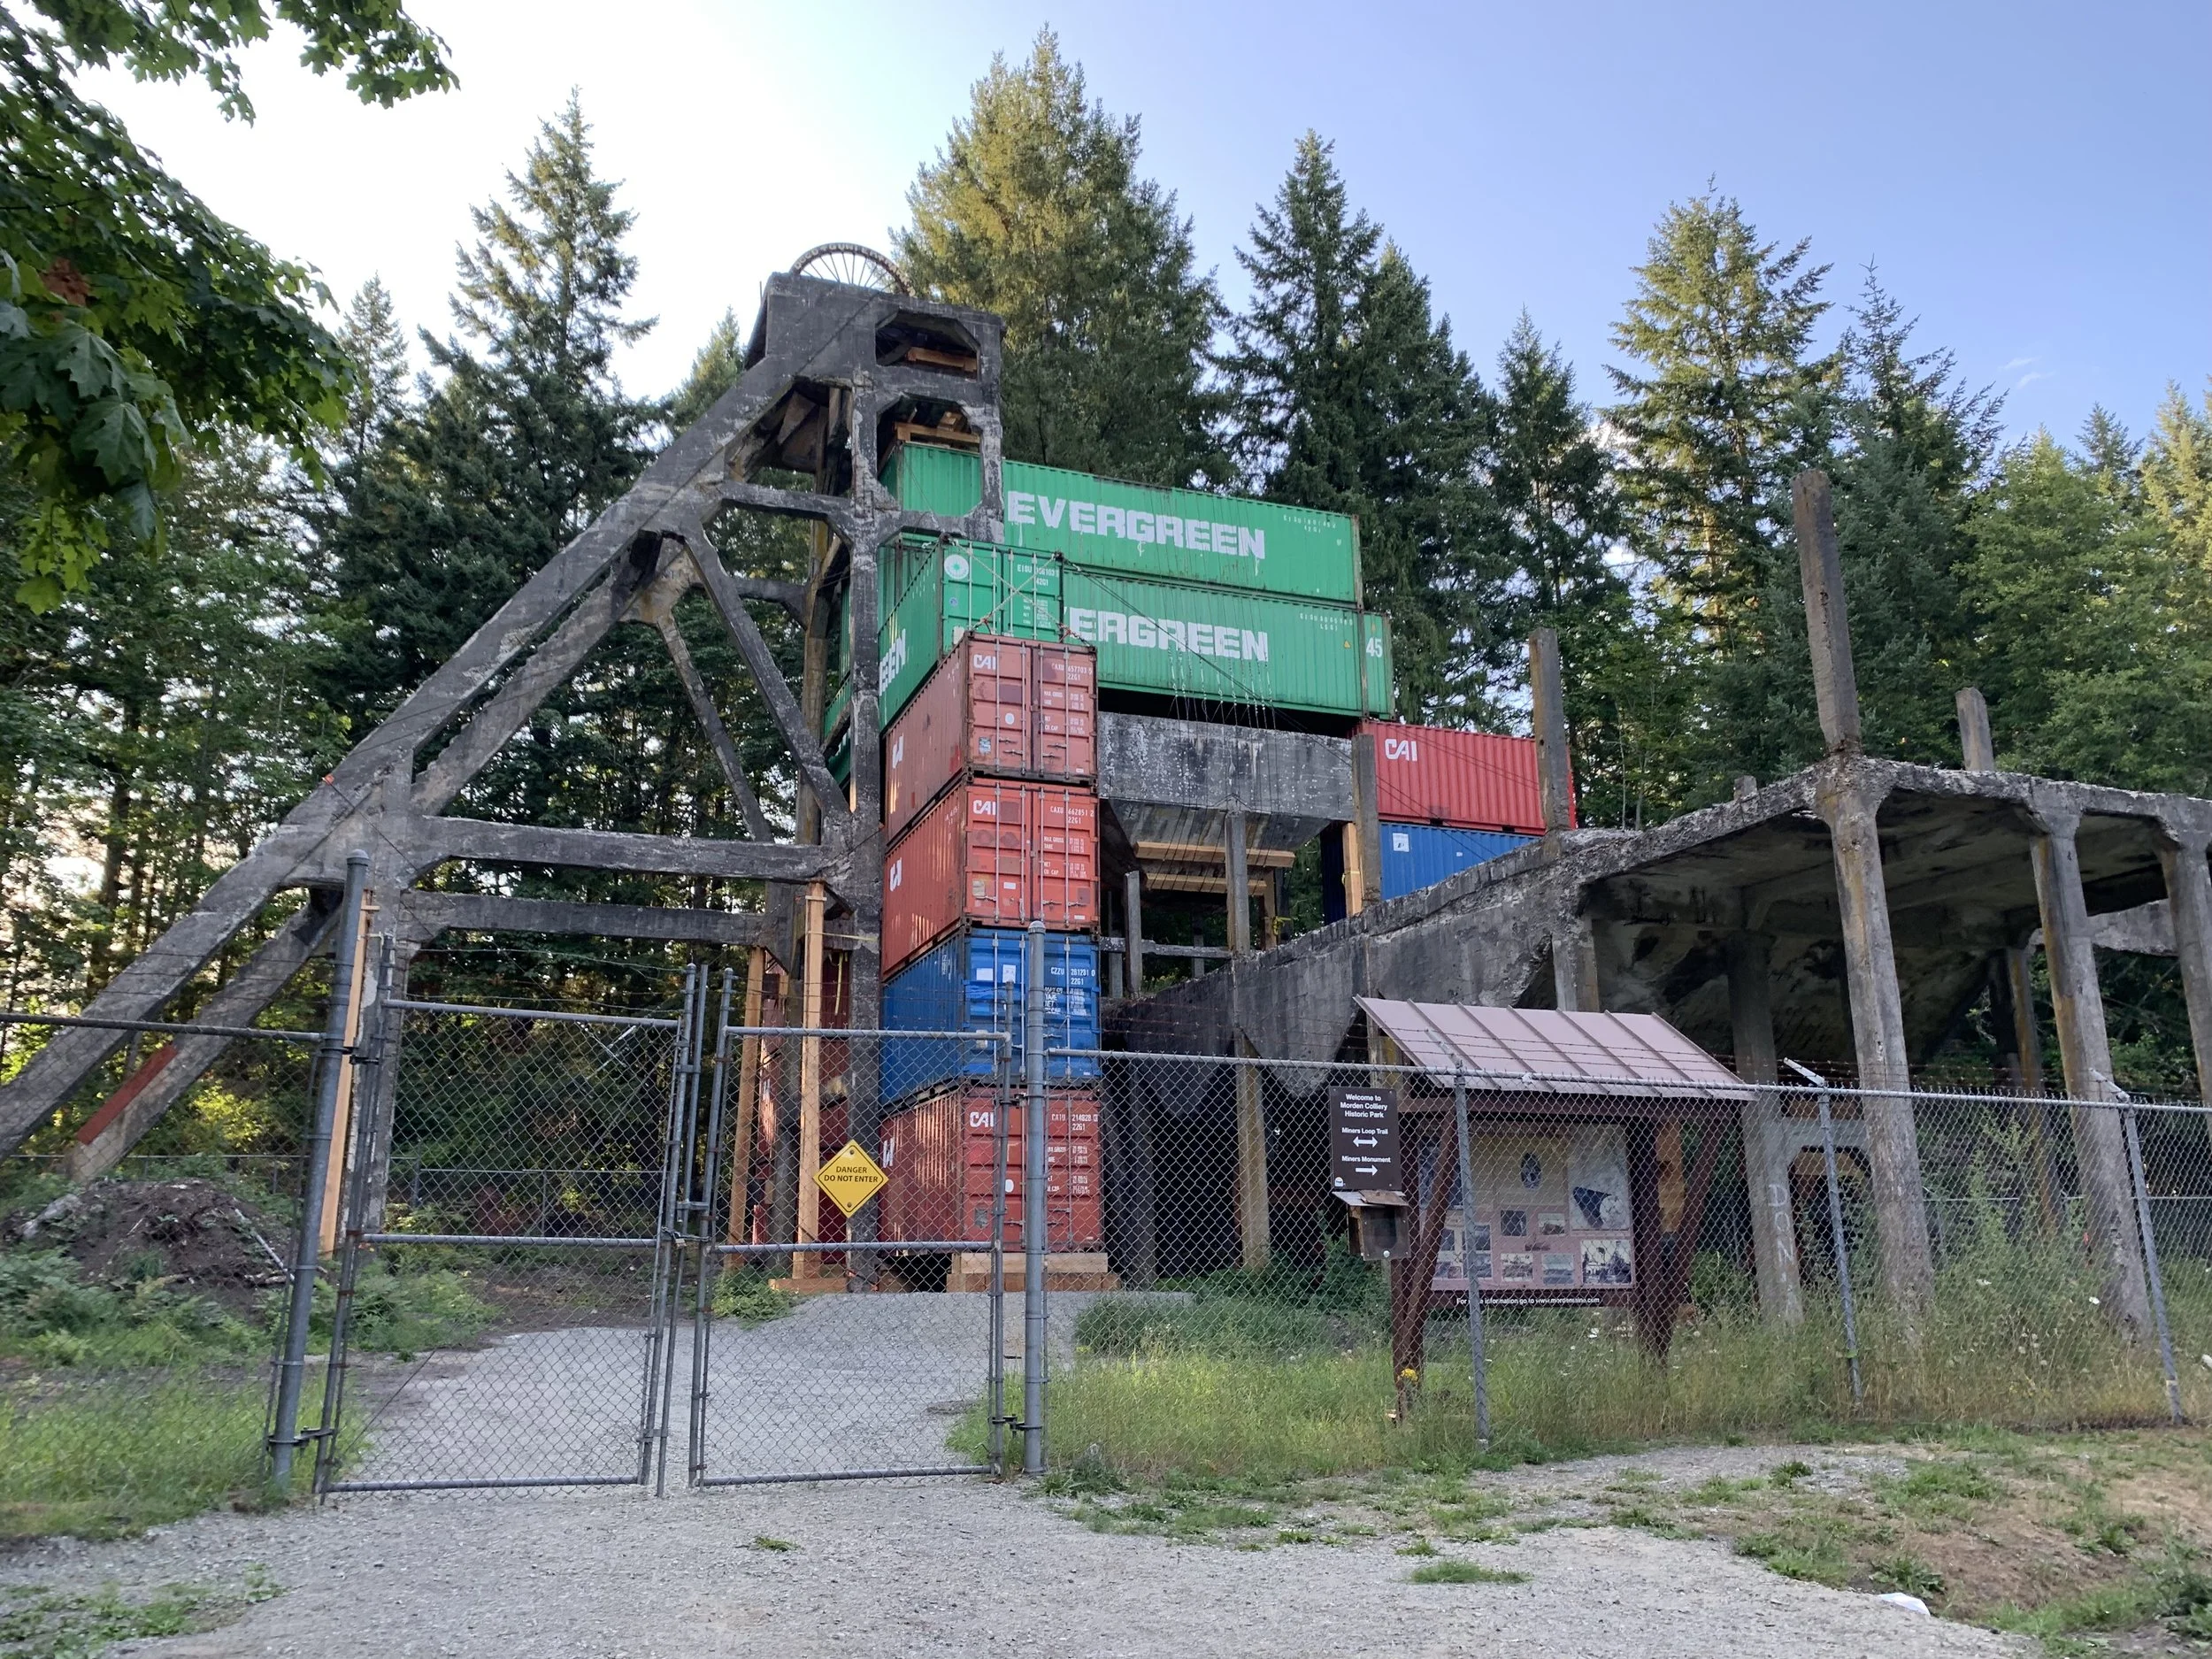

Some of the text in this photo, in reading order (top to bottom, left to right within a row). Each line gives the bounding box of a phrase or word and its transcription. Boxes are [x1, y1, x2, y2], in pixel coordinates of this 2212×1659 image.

[1008, 490, 1265, 559] EVERGREEN
[1064, 606, 1269, 663] ERGREEN
[1365, 637, 1383, 657] 45
[973, 654, 996, 670] CAI
[1384, 738, 1417, 761] CAI
[972, 799, 996, 815] CAI
[1049, 805, 1064, 814] CAXU
[1071, 977, 1084, 986] 22G1
[1364, 1102, 1387, 1111] Colliery
[970, 1111, 994, 1127] CAI
